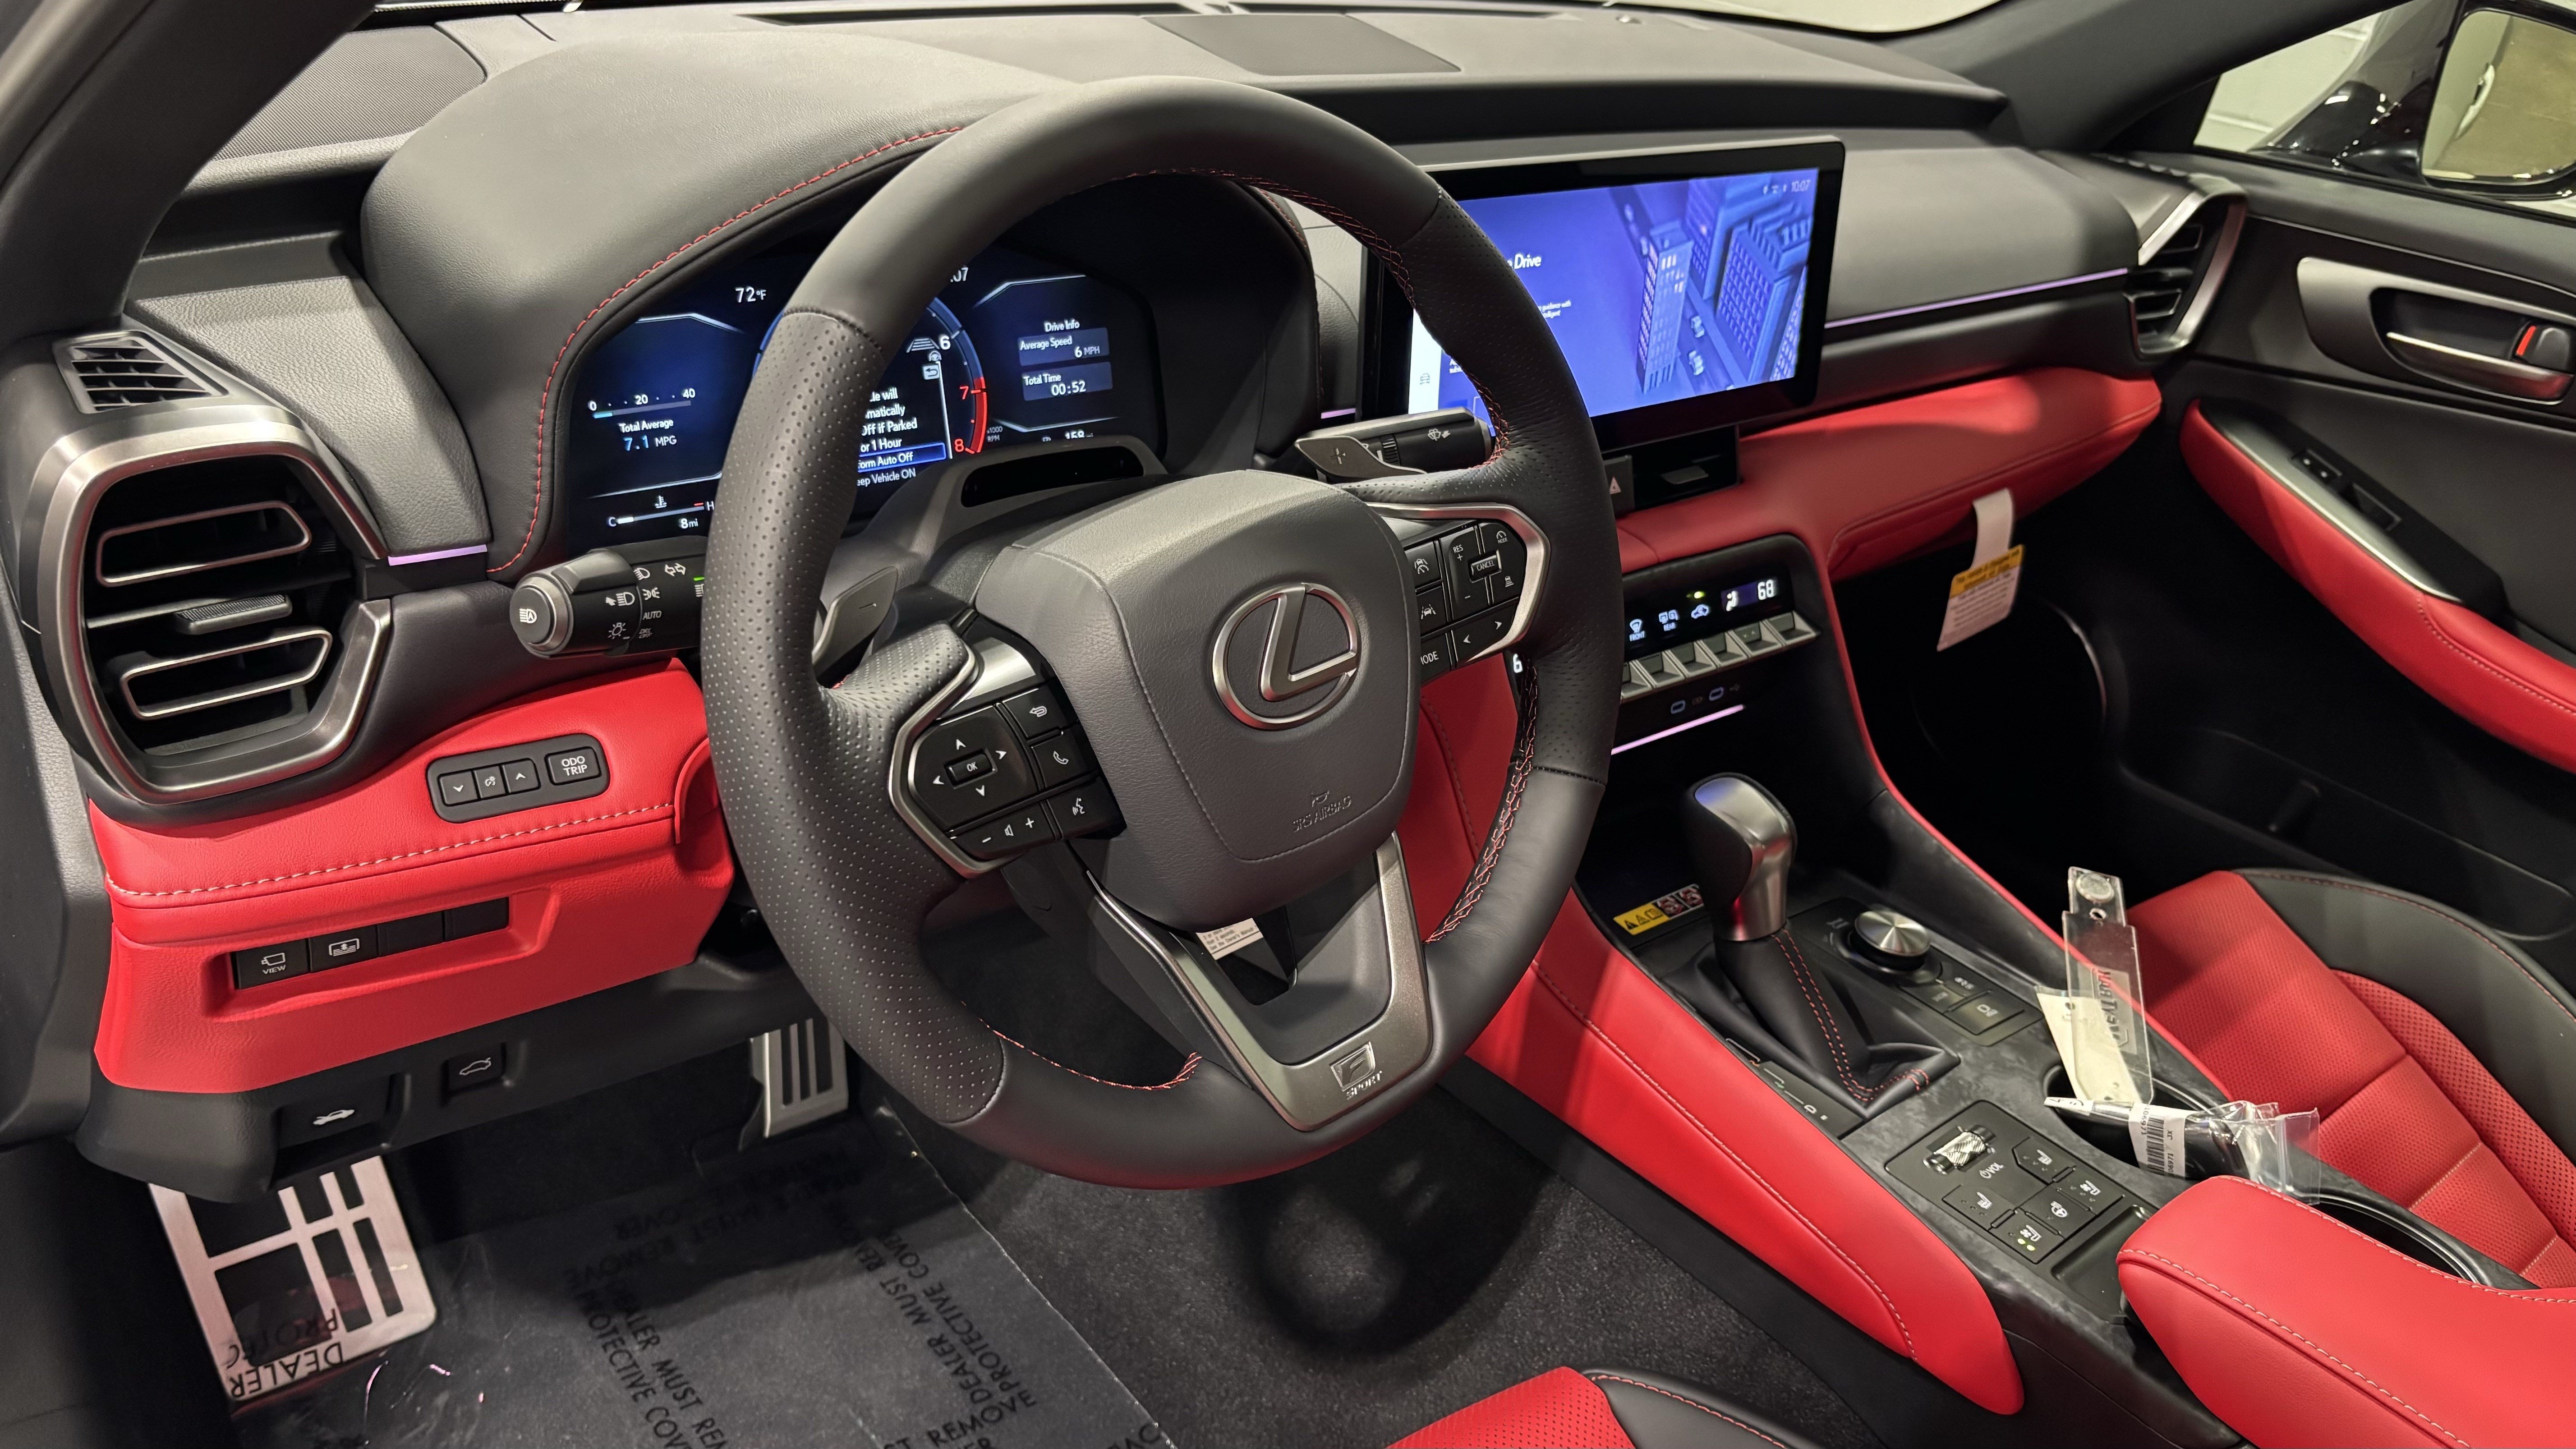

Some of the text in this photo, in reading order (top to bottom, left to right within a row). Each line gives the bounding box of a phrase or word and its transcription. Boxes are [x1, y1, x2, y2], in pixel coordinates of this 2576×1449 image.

[1514, 253, 1542, 270] Drive
[1044, 318, 1080, 332] Drive Info
[939, 336, 951, 350] 6
[1020, 335, 1072, 351] Average Speed
[1075, 346, 1100, 358] 6 MPH
[1024, 373, 1061, 386] Total Time
[882, 387, 898, 400] will
[959, 386, 969, 400] 7
[1051, 380, 1086, 396] 00:52
[589, 388, 695, 411] 0 20 40
[619, 418, 673, 433] Total Average
[878, 422, 885, 433] if
[887, 417, 917, 432] Parked
[624, 435, 677, 451] 7.1 MPG
[871, 440, 876, 451] 1
[879, 437, 902, 450] Hour
[954, 438, 964, 452] 8
[878, 456, 897, 466] Auto
[898, 451, 913, 463] Off
[871, 471, 900, 483] Vehicle
[902, 468, 916, 479] ON
[608, 501, 714, 528] C H
[1453, 544, 1463, 553] RES
[1476, 560, 1495, 571] CANCEL
[1757, 579, 1776, 600] 68
[643, 611, 662, 620] AUTO
[561, 755, 585, 767] ODO
[966, 762, 978, 772] OK
[563, 764, 588, 777] TRIP
[1293, 796, 1351, 833] SRS AIRBAG
[262, 964, 286, 975] VIEW
[1346, 1070, 1382, 1100] SPORT
[1985, 1162, 2004, 1174] VOL
[879, 1276, 932, 1325] MUST
[923, 1282, 1021, 1392] PROTECTIVE
[230, 1342, 343, 1398] DEALER
[927, 1334, 992, 1404] DEALER
[651, 1359, 704, 1411] MUST
[927, 1389, 1037, 1448] REMOVE
